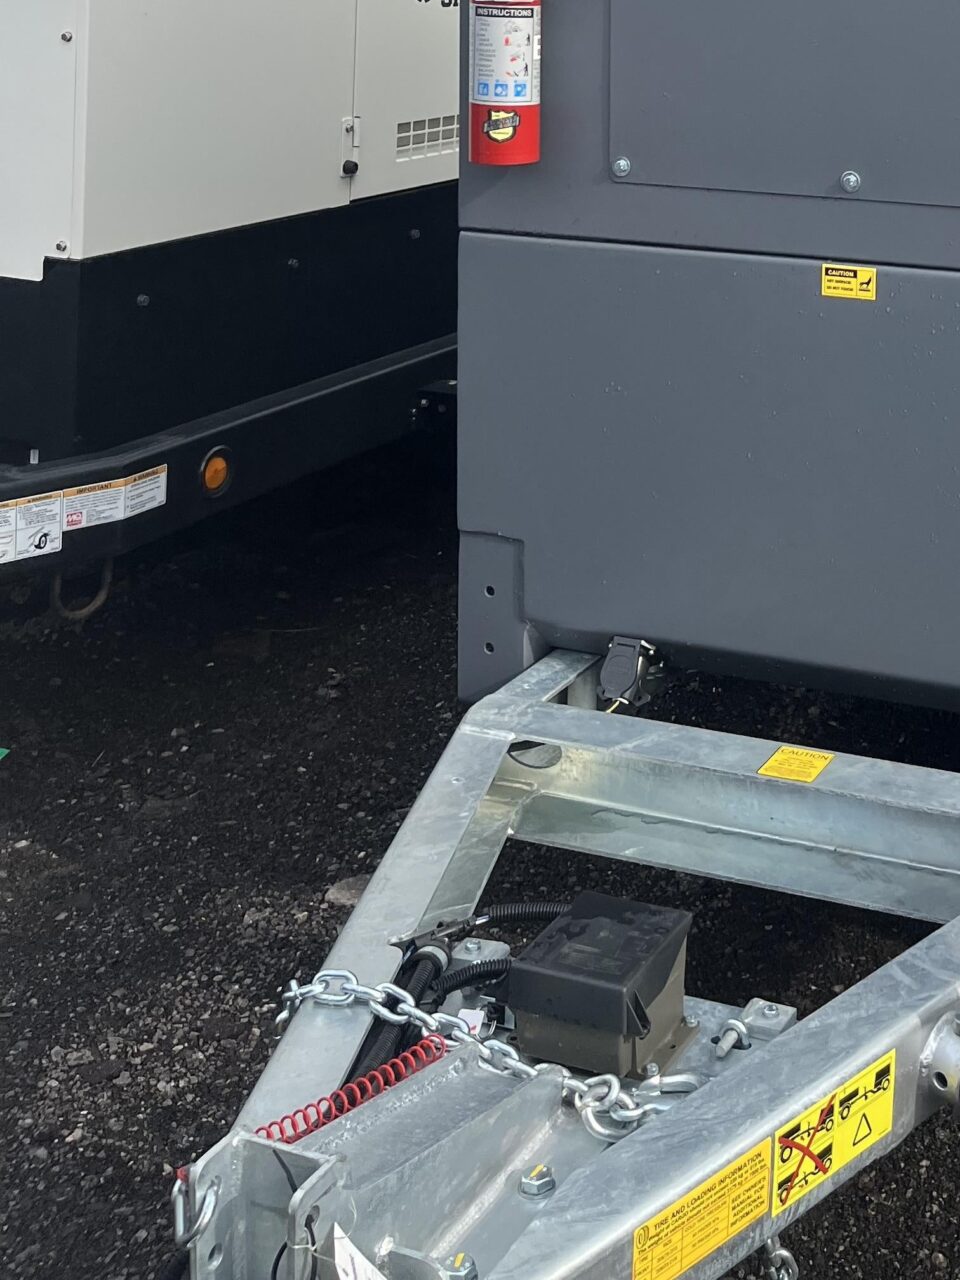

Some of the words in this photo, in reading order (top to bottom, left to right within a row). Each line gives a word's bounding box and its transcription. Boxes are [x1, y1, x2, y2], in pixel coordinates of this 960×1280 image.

[476, 8, 532, 17] INSTRUCTIONS
[827, 269, 855, 278] CAUTION
[76, 483, 112, 494] IMPORTANT
[780, 748, 829, 761] CAUTION
[654, 1214, 669, 1232] TIRE
[671, 1204, 685, 1220] AND
[686, 1182, 716, 1209] LOADING
[718, 1151, 761, 1187] INFORMATION
[731, 1193, 752, 1212] MANUAL
[733, 1193, 762, 1219] ADDITIONAL
[730, 1198, 765, 1228] INFORMATION
